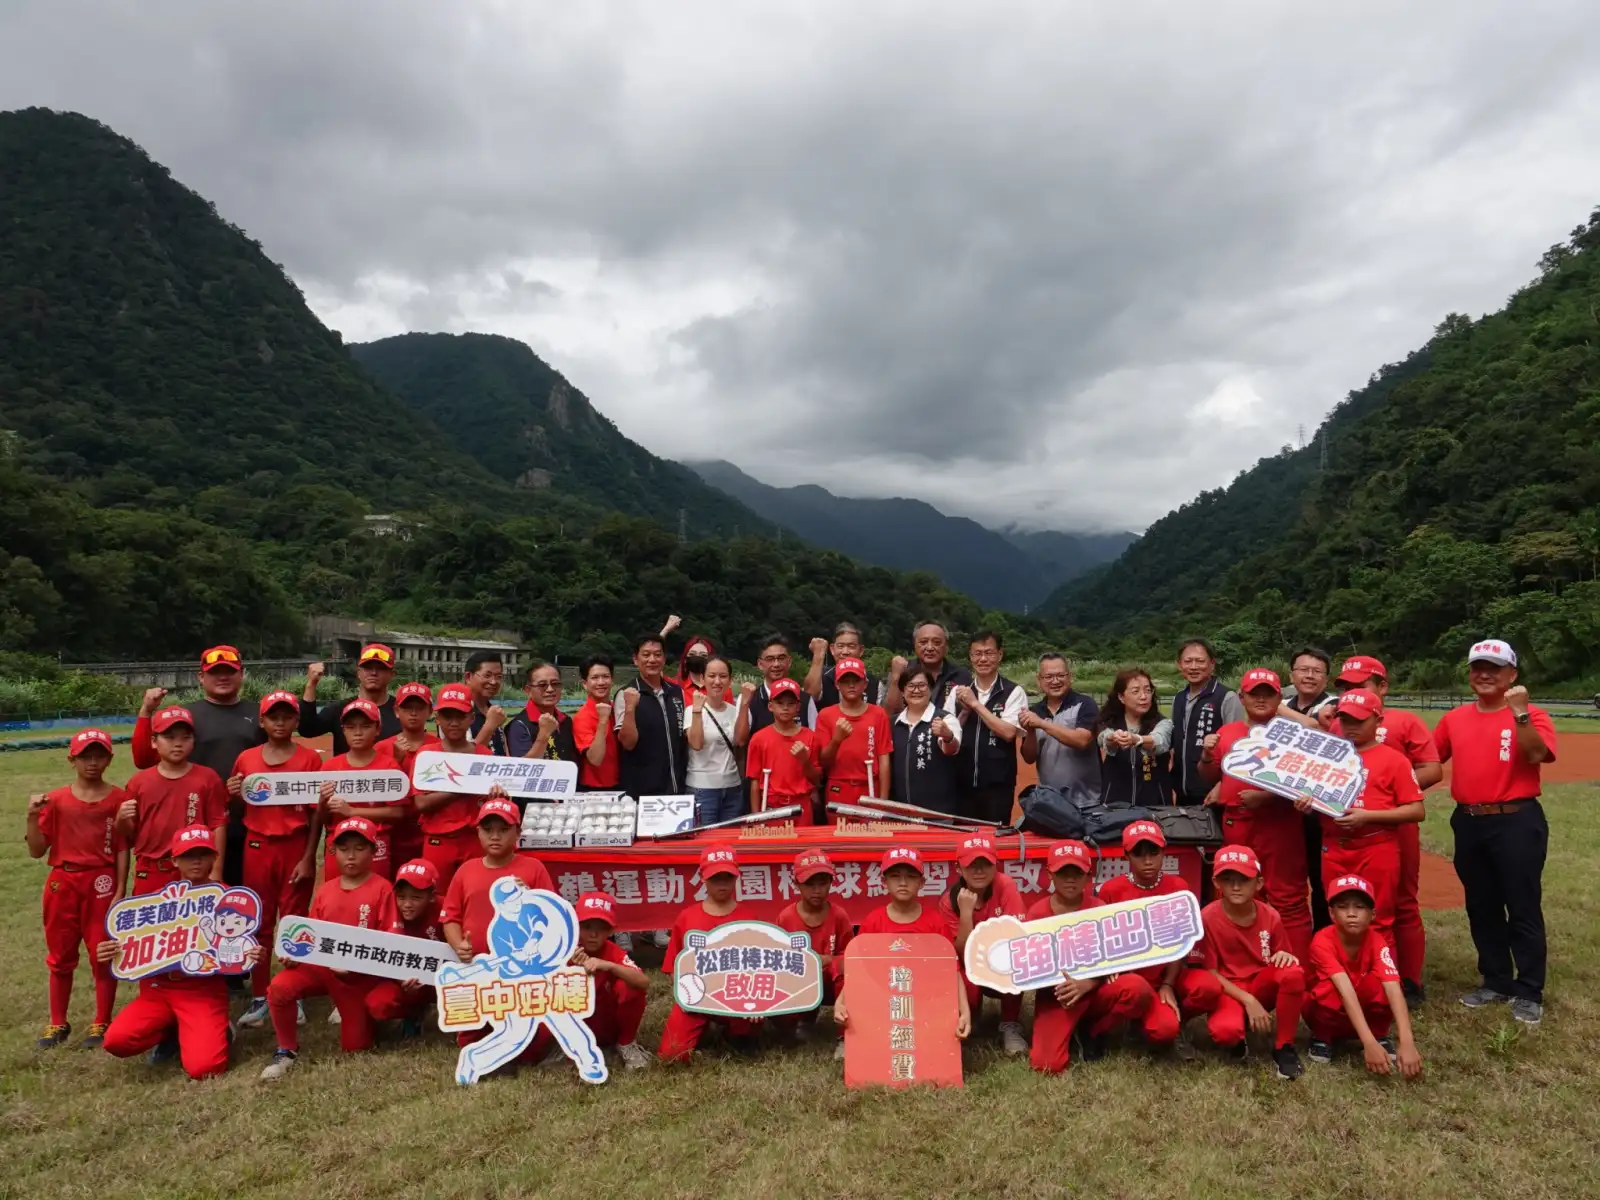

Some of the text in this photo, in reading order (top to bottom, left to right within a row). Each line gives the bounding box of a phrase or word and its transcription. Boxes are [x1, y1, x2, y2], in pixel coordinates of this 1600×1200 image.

[1265, 719, 1351, 763] 酷運動
[468, 761, 546, 777] 臺中市政府
[522, 778, 570, 793] 運動局
[1274, 750, 1353, 788] 酷城市
[643, 798, 691, 815] EXP
[115, 895, 216, 932] 德芙蘭小將
[119, 926, 199, 972] 加油!
[319, 936, 452, 973] 臺中市政府教育
[1010, 895, 1196, 985] 強棒出擊
[696, 947, 806, 976] 松鶴棒球場
[442, 972, 589, 1026] 臺中好棒
[888, 965, 916, 1081] 培訓經費
